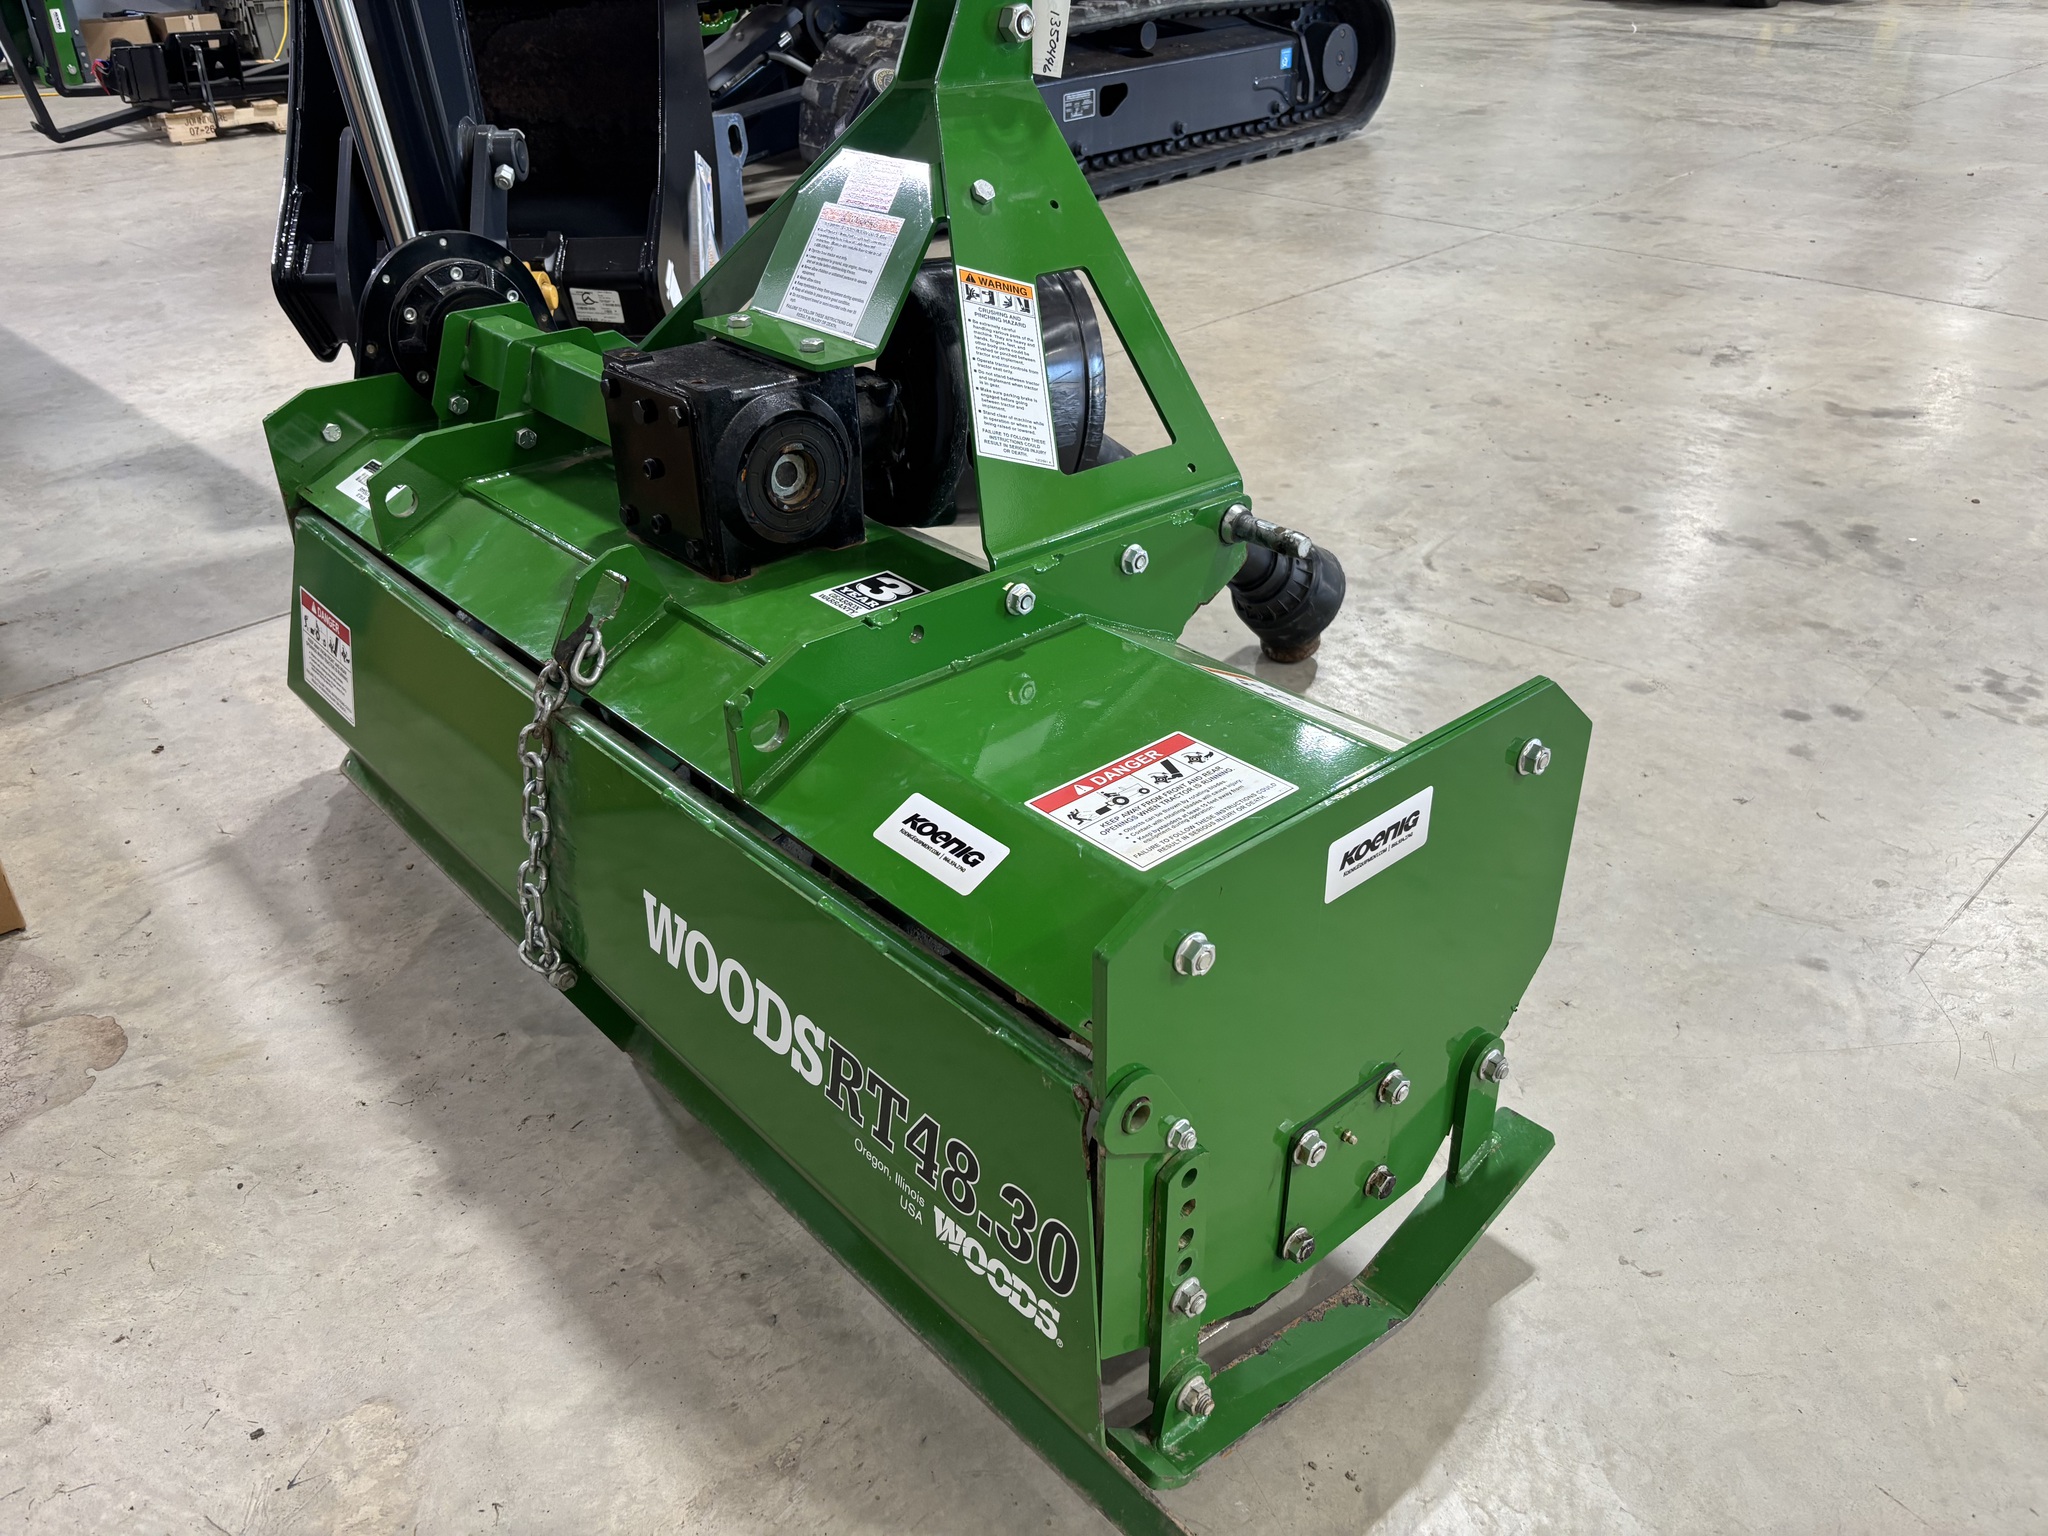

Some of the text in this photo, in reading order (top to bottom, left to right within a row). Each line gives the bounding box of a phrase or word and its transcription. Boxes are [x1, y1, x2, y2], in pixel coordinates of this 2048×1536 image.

[1043, 10, 1061, 73] 1350446
[189, 125, 215, 136] 07-26
[978, 277, 1027, 296] WARNING
[974, 312, 1027, 328] PINCHING HAZARD
[978, 307, 1008, 318] CRUSHING
[984, 439, 1002, 447] RESULT
[1009, 444, 1029, 452] SERIOUS
[989, 435, 1023, 445] INSTRUCTIONS
[1010, 434, 1030, 442] FOLLOW
[838, 586, 880, 608] YEAR
[856, 577, 914, 601] 3
[317, 608, 340, 635] DANGER
[1089, 750, 1165, 786] DANGER
[1098, 766, 1224, 828] KEEP AWAY FROM FRONT AND REAR
[1098, 815, 1140, 836] OPENINGS
[1135, 804, 1162, 817] WHEN
[1159, 787, 1195, 805] TRACTOR
[1199, 767, 1236, 785] RUNNING.
[1122, 821, 1147, 834] Objects
[1161, 802, 1182, 813] thrown
[1187, 789, 1211, 801] rotating
[1129, 824, 1153, 837] Contact
[1150, 818, 1165, 826] with
[1162, 808, 1187, 820] rotating
[1183, 799, 1203, 809] blades
[1210, 787, 1228, 796] cause
[1136, 832, 1155, 841] Keep
[1151, 817, 1184, 834] bystanders
[1186, 807, 1202, 815] least
[1217, 792, 1234, 800] away
[1229, 785, 1245, 793] from
[1132, 843, 1162, 858] FAILURE
[1168, 825, 1197, 840] FOLLOW
[1193, 814, 1217, 826] THESE
[1213, 793, 1258, 816] INSTRUCTIONS
[1254, 782, 1278, 794] COULD
[1156, 839, 1183, 853] RESULT
[1187, 821, 1217, 837] SERIOUS
[1213, 810, 1238, 823] INJURY
[644, 889, 1079, 1297] WOODS RT48.30
[854, 1138, 925, 1207] Oregon, Illinois
[900, 1195, 923, 1225] USA
